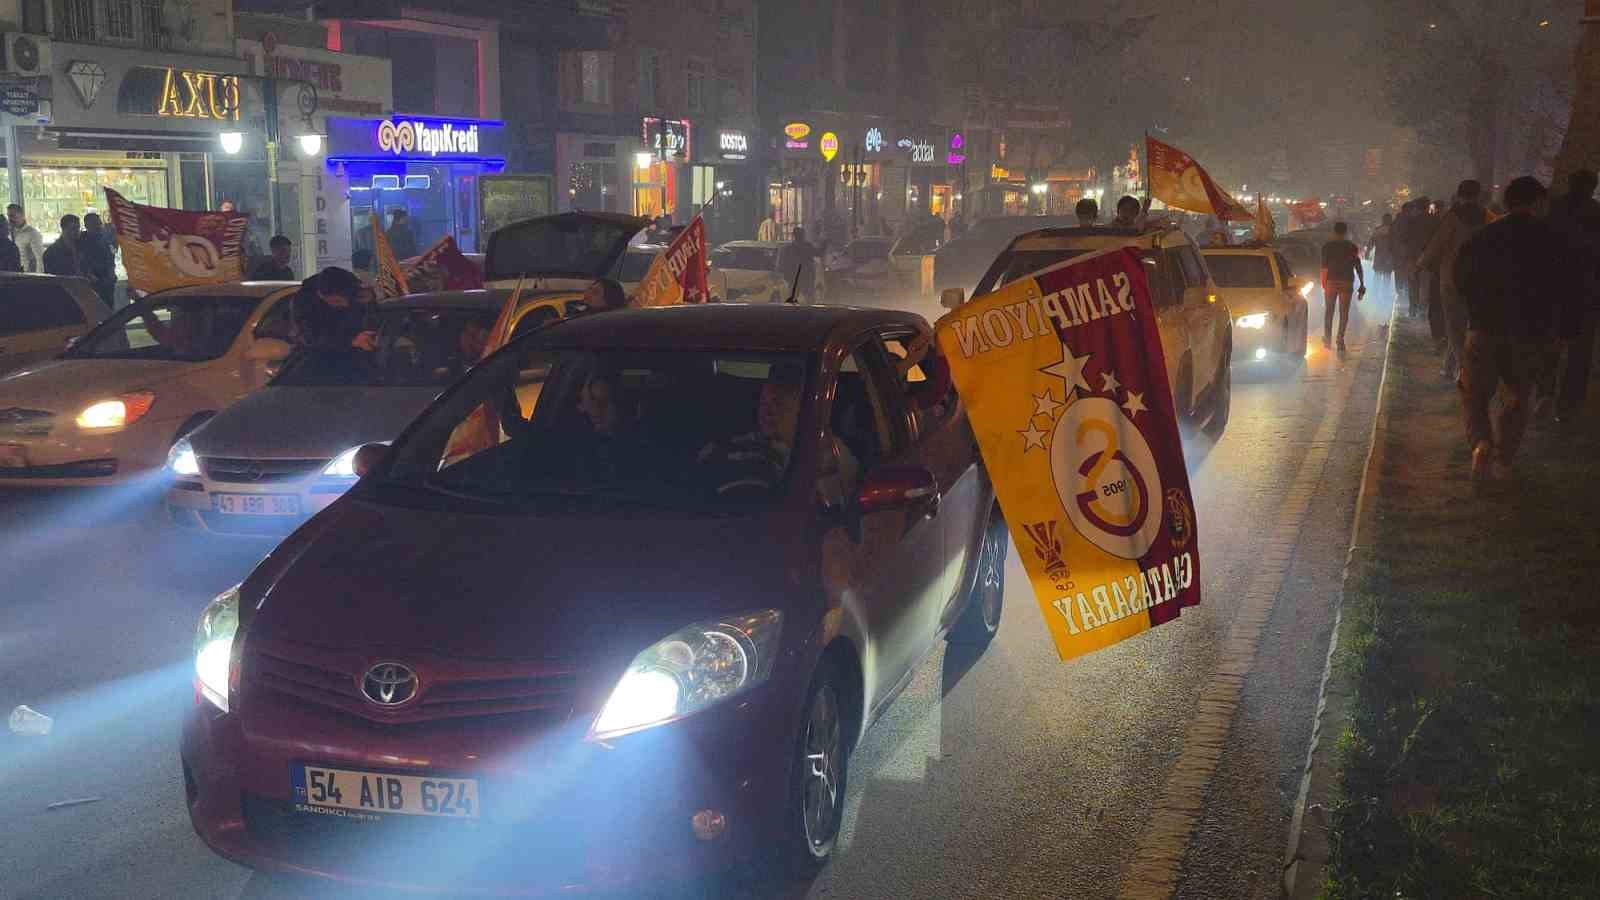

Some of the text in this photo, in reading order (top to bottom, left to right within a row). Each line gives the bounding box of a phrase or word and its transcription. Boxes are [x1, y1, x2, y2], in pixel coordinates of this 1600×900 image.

[310, 771, 473, 815] 54 AIB 624
